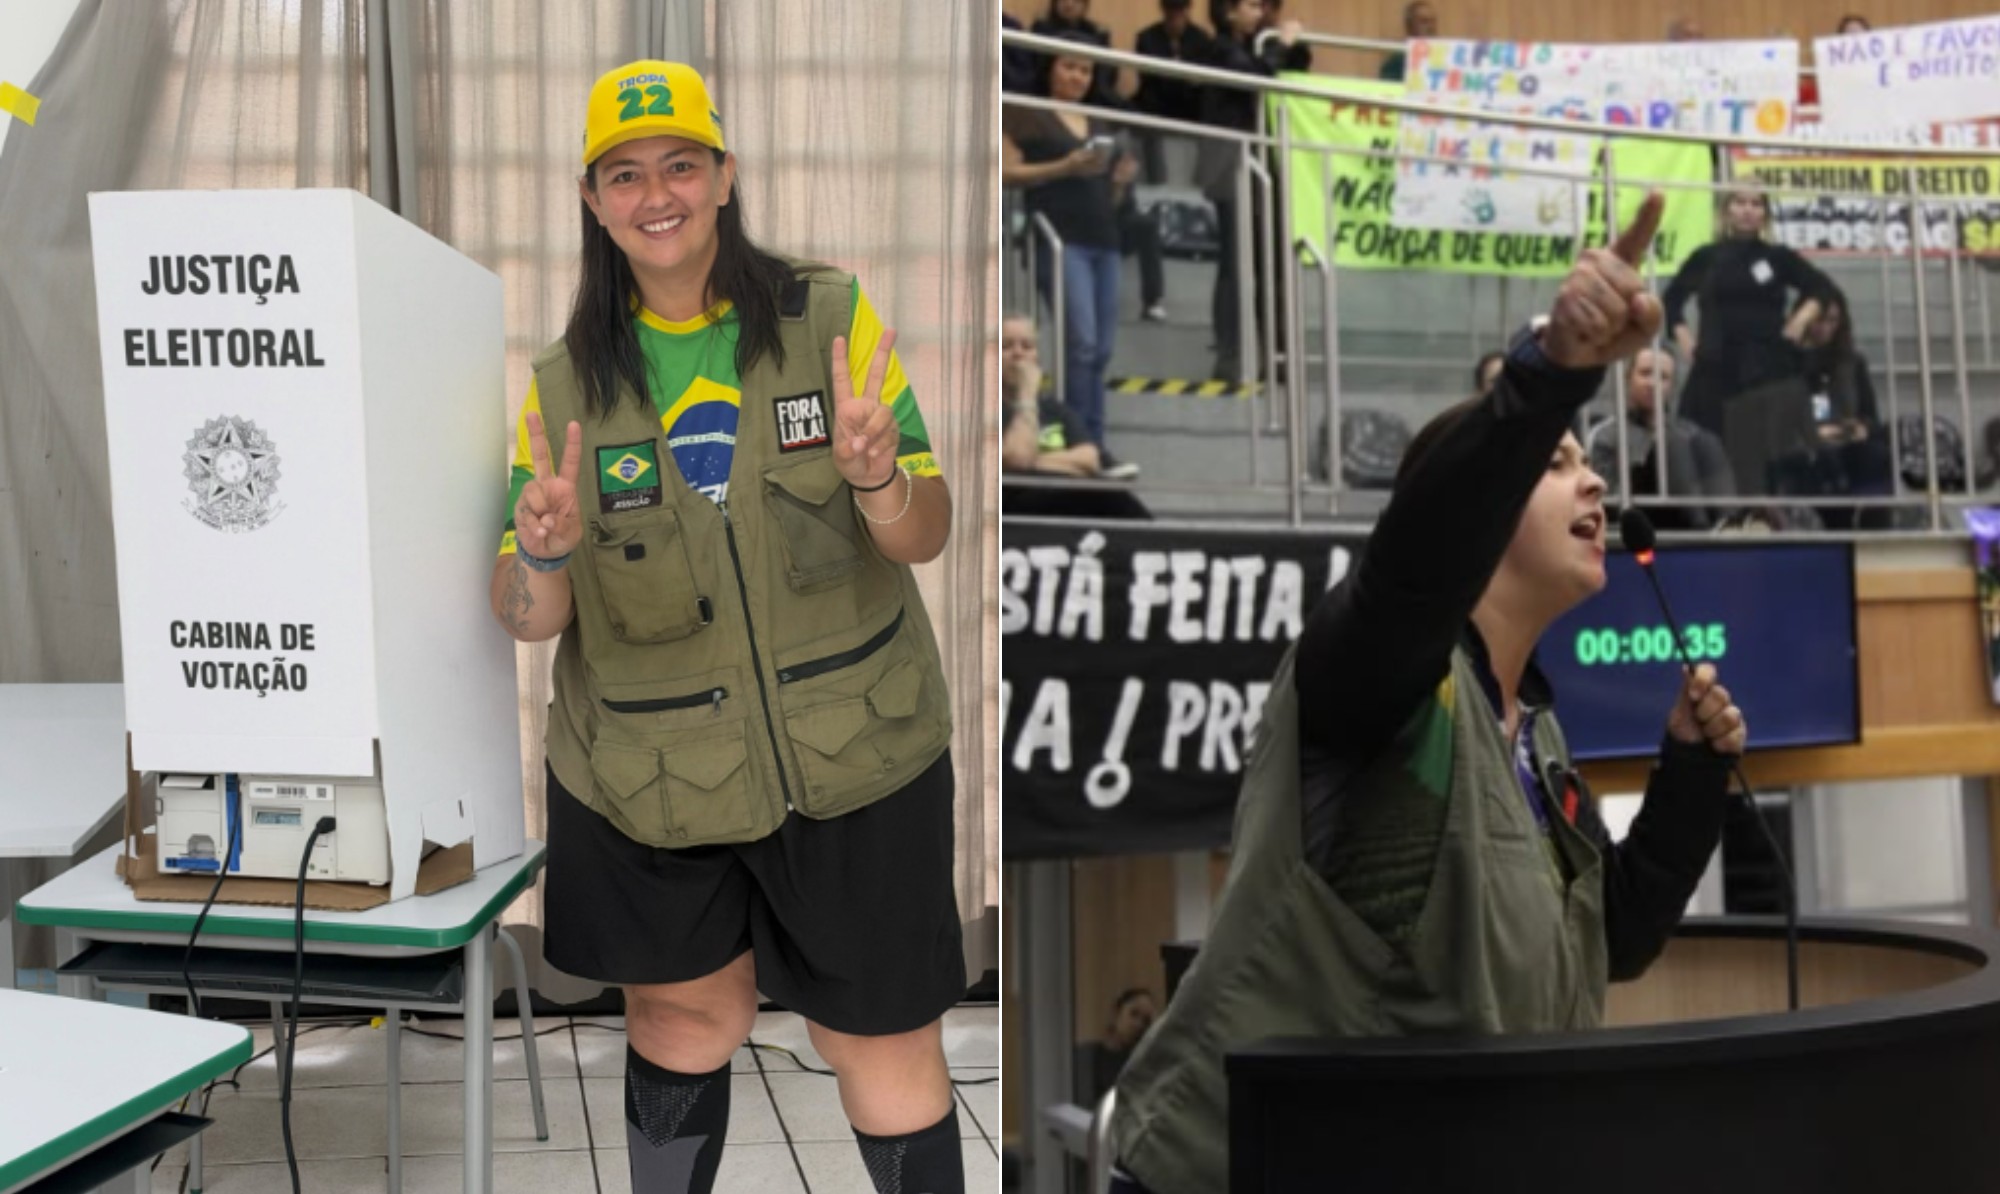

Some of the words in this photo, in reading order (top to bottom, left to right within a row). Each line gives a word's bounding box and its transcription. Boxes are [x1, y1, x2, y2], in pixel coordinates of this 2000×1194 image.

[1921, 24, 2000, 54] FAVO
[618, 74, 667, 89] TROPA
[616, 85, 674, 122] 22
[1883, 166, 1991, 196] DIREITO
[1333, 220, 1442, 265] FORÇA
[1451, 232, 1486, 264] DE
[1492, 234, 1575, 267] QUEM
[140, 253, 301, 306] JUSTIÇA
[123, 328, 326, 368] ELEITORAL
[776, 394, 824, 424] FORA
[780, 416, 827, 445] LULA!
[1128, 549, 1305, 643] FEITA
[169, 620, 272, 649] CABINA
[280, 623, 316, 651] DE
[181, 657, 308, 697] VOTAÇÃO
